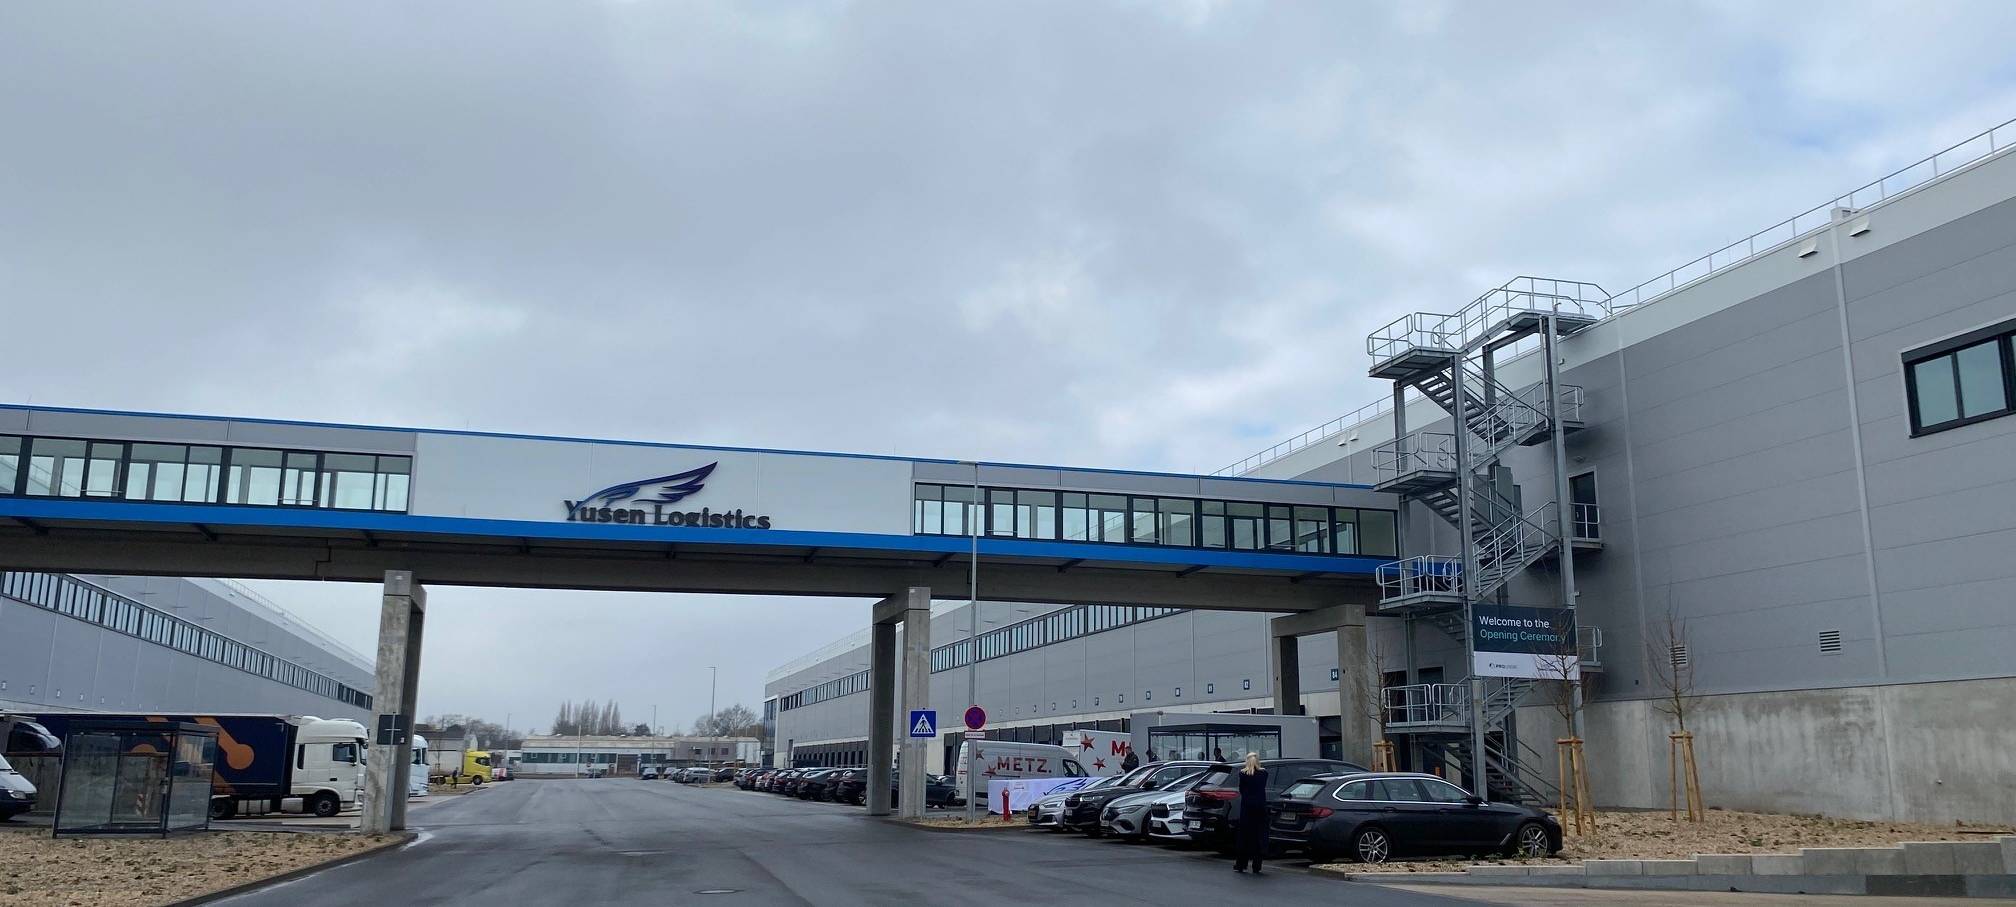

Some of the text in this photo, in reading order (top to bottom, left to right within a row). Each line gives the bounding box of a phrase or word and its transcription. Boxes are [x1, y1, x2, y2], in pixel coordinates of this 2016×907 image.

[563, 500, 771, 530] Yusen Logistics
[1479, 616, 1550, 629] Welcome to the
[1480, 629, 1518, 642] Opening
